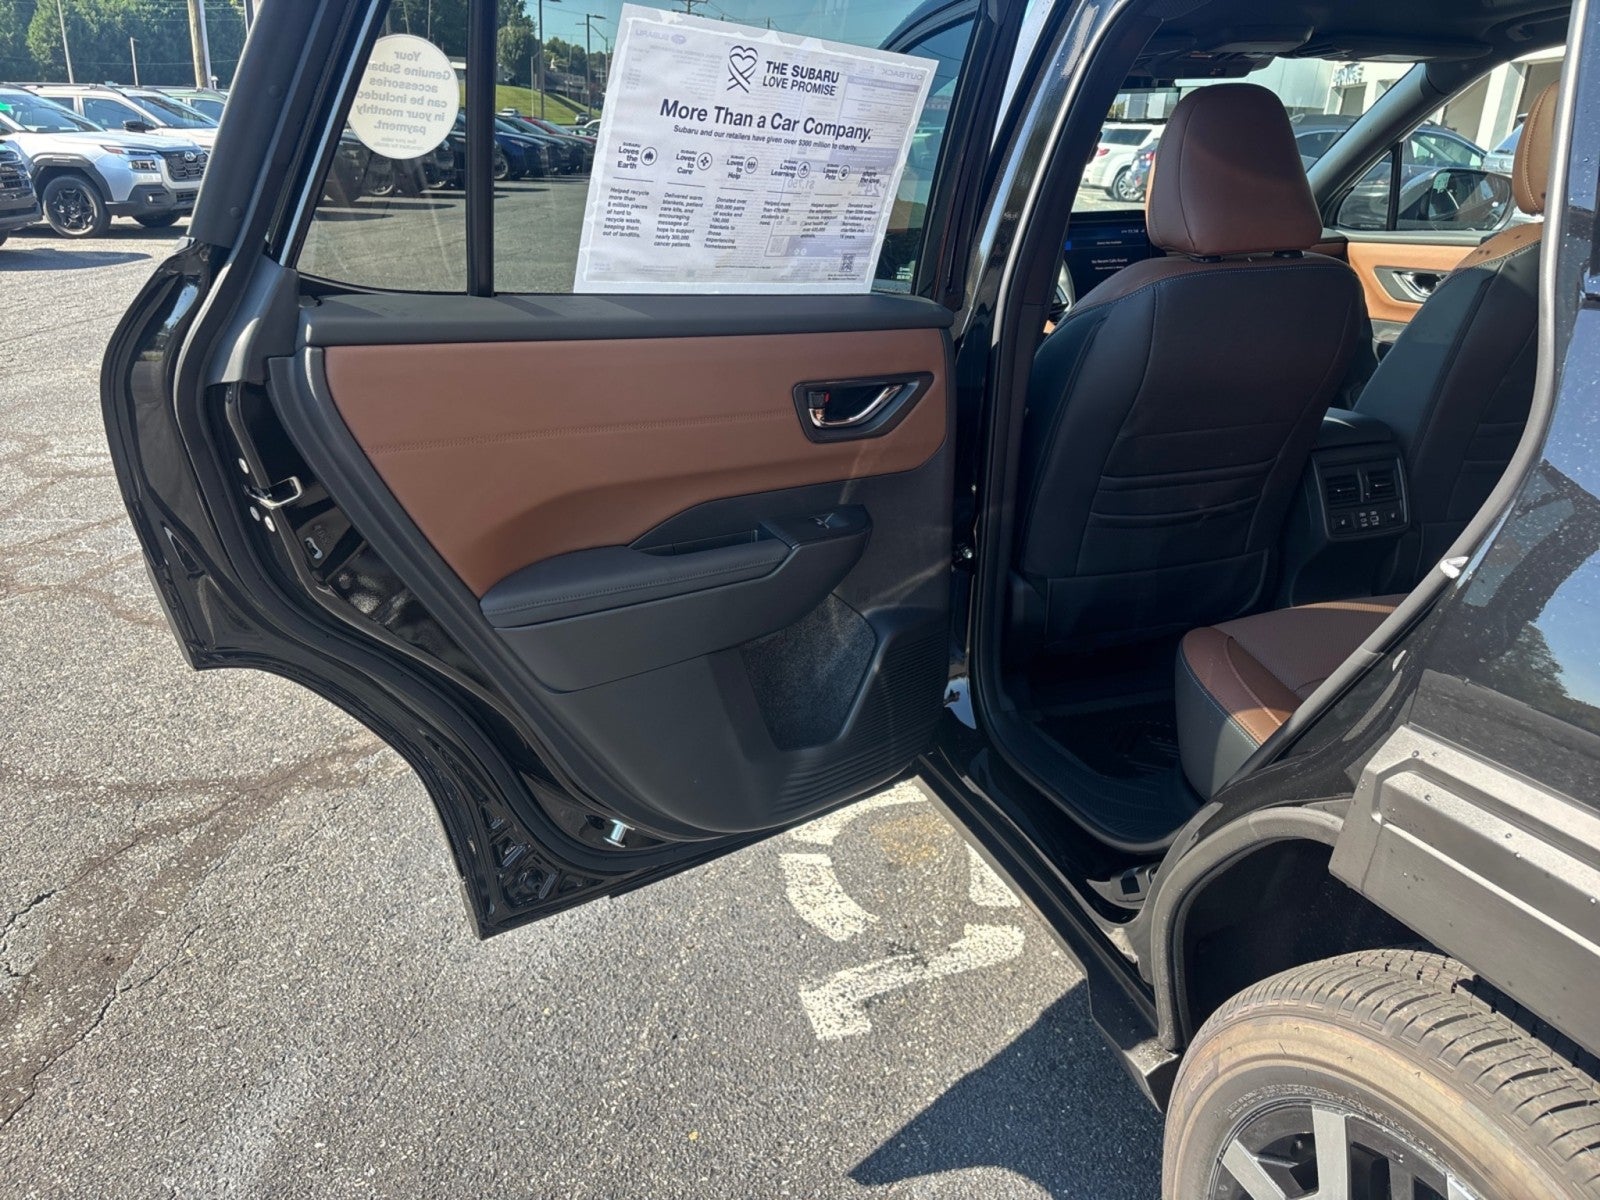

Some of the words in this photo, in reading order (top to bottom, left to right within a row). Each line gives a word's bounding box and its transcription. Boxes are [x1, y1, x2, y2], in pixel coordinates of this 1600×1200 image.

[765, 61, 788, 76] THE
[791, 64, 840, 84] SUBARU
[762, 75, 788, 90] LOVE
[790, 80, 837, 97] PROMISE
[660, 99, 708, 122] More
[714, 106, 753, 128] Than
[757, 115, 766, 129] a
[770, 113, 800, 132] Car
[803, 117, 873, 144] Company.
[673, 124, 699, 136] Subaru
[700, 128, 712, 138] and
[713, 131, 725, 139] our
[726, 131, 751, 141] retailers
[752, 134, 766, 143] have
[766, 135, 782, 145] given
[813, 140, 831, 149] million
[832, 142, 838, 150] to
[838, 142, 858, 152] charity.
[618, 146, 639, 155] Loves
[626, 154, 638, 162] the
[675, 154, 695, 162] Loves
[617, 161, 637, 169] Earth
[726, 159, 744, 167] Loves
[677, 167, 694, 175] Care
[780, 163, 797, 172] Loves
[727, 172, 741, 180] Help
[770, 170, 796, 179] Learning
[610, 187, 630, 195] Helped
[630, 188, 649, 196] recycle
[664, 192, 688, 200] Delivered
[603, 223, 625, 231] keeping
